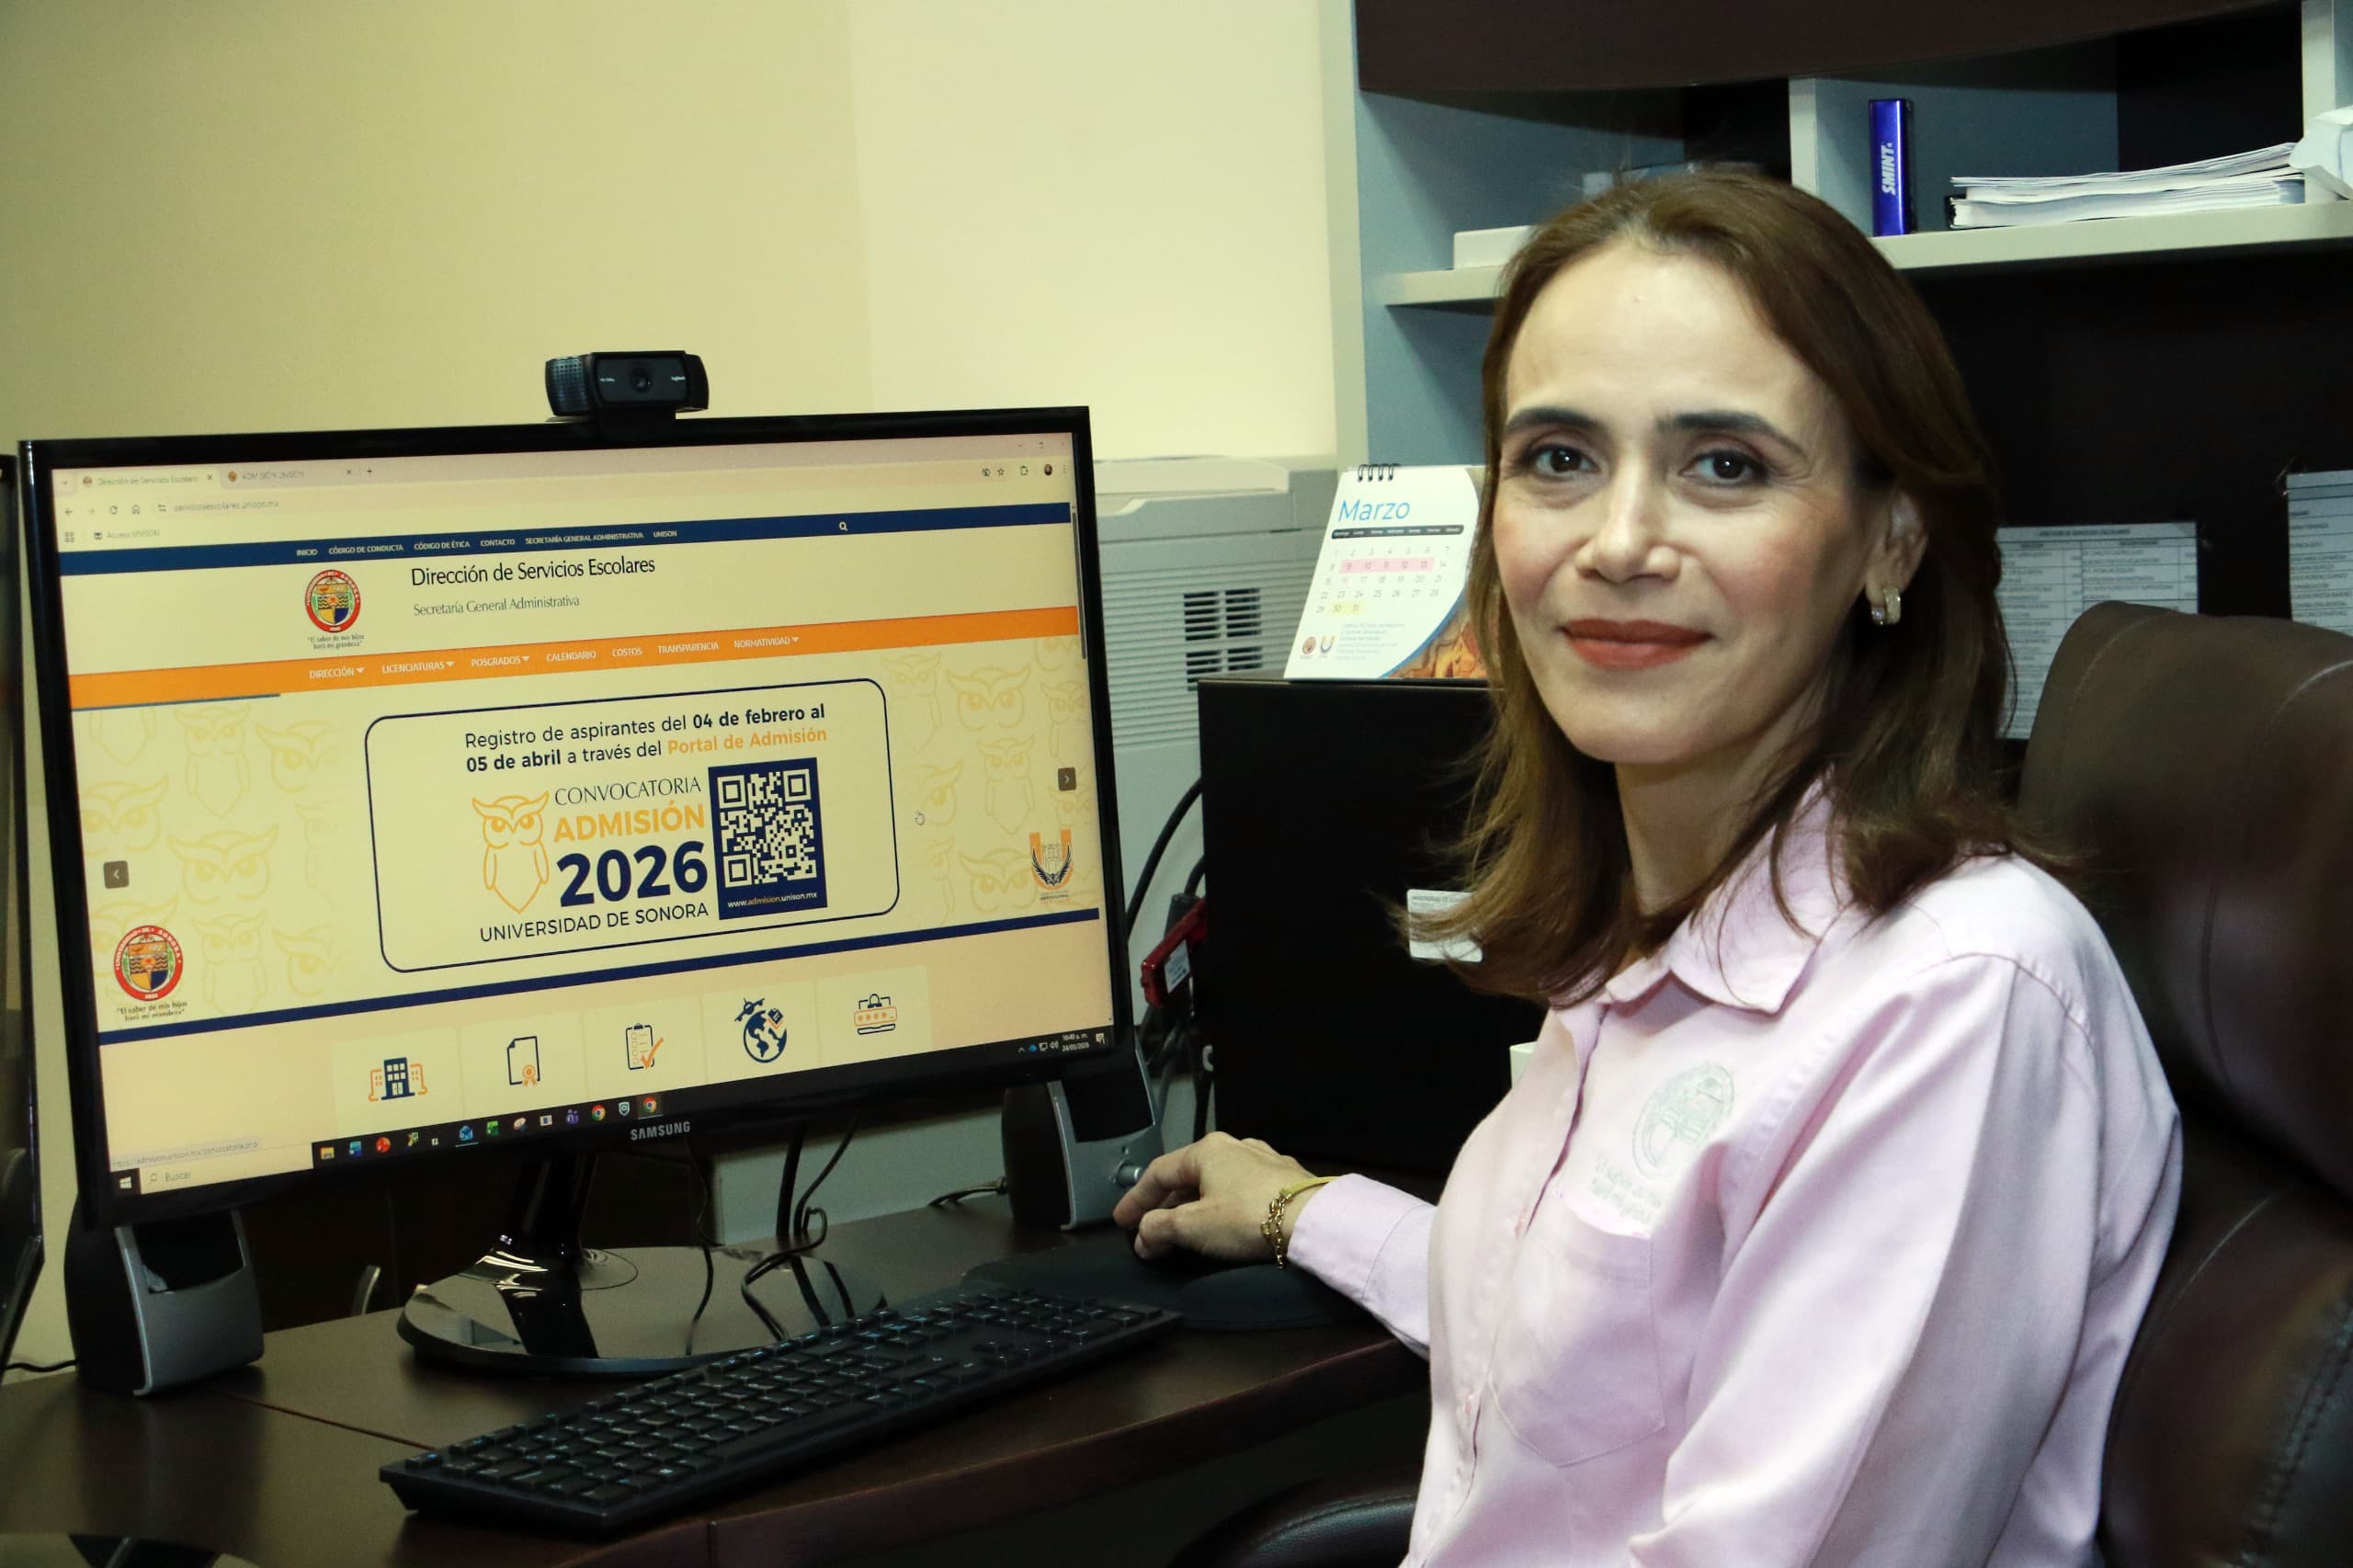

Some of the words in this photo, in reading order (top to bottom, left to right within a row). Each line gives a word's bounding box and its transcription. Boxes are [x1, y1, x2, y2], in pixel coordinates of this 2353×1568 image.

[1881, 142, 1896, 196] SMINT
[1338, 498, 1410, 523] Marzo
[525, 535, 563, 545] SECRETARÍA
[563, 534, 592, 542] GENERAL
[593, 532, 644, 541] ADMINISTRATIVA
[653, 530, 677, 539] UNISON
[328, 546, 356, 555] CÓDIGO
[367, 544, 404, 553] CONDUCTA
[414, 540, 440, 551] CÓDIGO
[441, 541, 451, 550] DE
[451, 540, 471, 549] ÉTICA
[480, 539, 516, 548] CONTACTO
[296, 549, 318, 557] INICIO
[411, 564, 489, 585] Dirección
[493, 562, 514, 582] de
[517, 560, 585, 580] Servicios
[588, 555, 655, 576] Escolares
[413, 601, 464, 617] Secretaría
[466, 597, 507, 613] General
[508, 595, 580, 610] Administrativa
[657, 642, 720, 654] TRANSPARENCIA
[733, 637, 790, 649] NORMATIVIDAD
[546, 650, 597, 663] CALENDARIO
[612, 647, 642, 658] COSTOS
[381, 661, 445, 674] LICENCIATURAS
[471, 655, 521, 667] POSGRADOS
[309, 665, 355, 679] DIRECCIÓN
[465, 730, 536, 750] Registro
[542, 726, 563, 742] de
[570, 721, 655, 742] aspirantes
[661, 715, 687, 732] del
[693, 713, 712, 729] 04
[719, 711, 740, 727] de
[745, 708, 805, 724] febrero
[811, 703, 825, 719] al
[466, 756, 487, 772] 05
[494, 754, 516, 770] de
[521, 749, 561, 767] abril
[567, 751, 576, 764] a
[582, 744, 631, 762] través
[636, 740, 662, 757] del
[668, 735, 718, 755] Portal
[723, 733, 745, 750] de
[749, 727, 827, 748] Admisión
[554, 777, 701, 806] CONVOCATORIA
[553, 800, 705, 843] ADMISIÓN
[556, 840, 708, 907] 2026
[727, 892, 818, 908] www.admision.unison.mx
[480, 915, 601, 942] UNIVERSIDAD
[607, 911, 630, 927] DE
[635, 903, 709, 925] SONORA
[631, 1120, 691, 1141] SAMSUNG
[165, 1172, 191, 1182] Buscar
